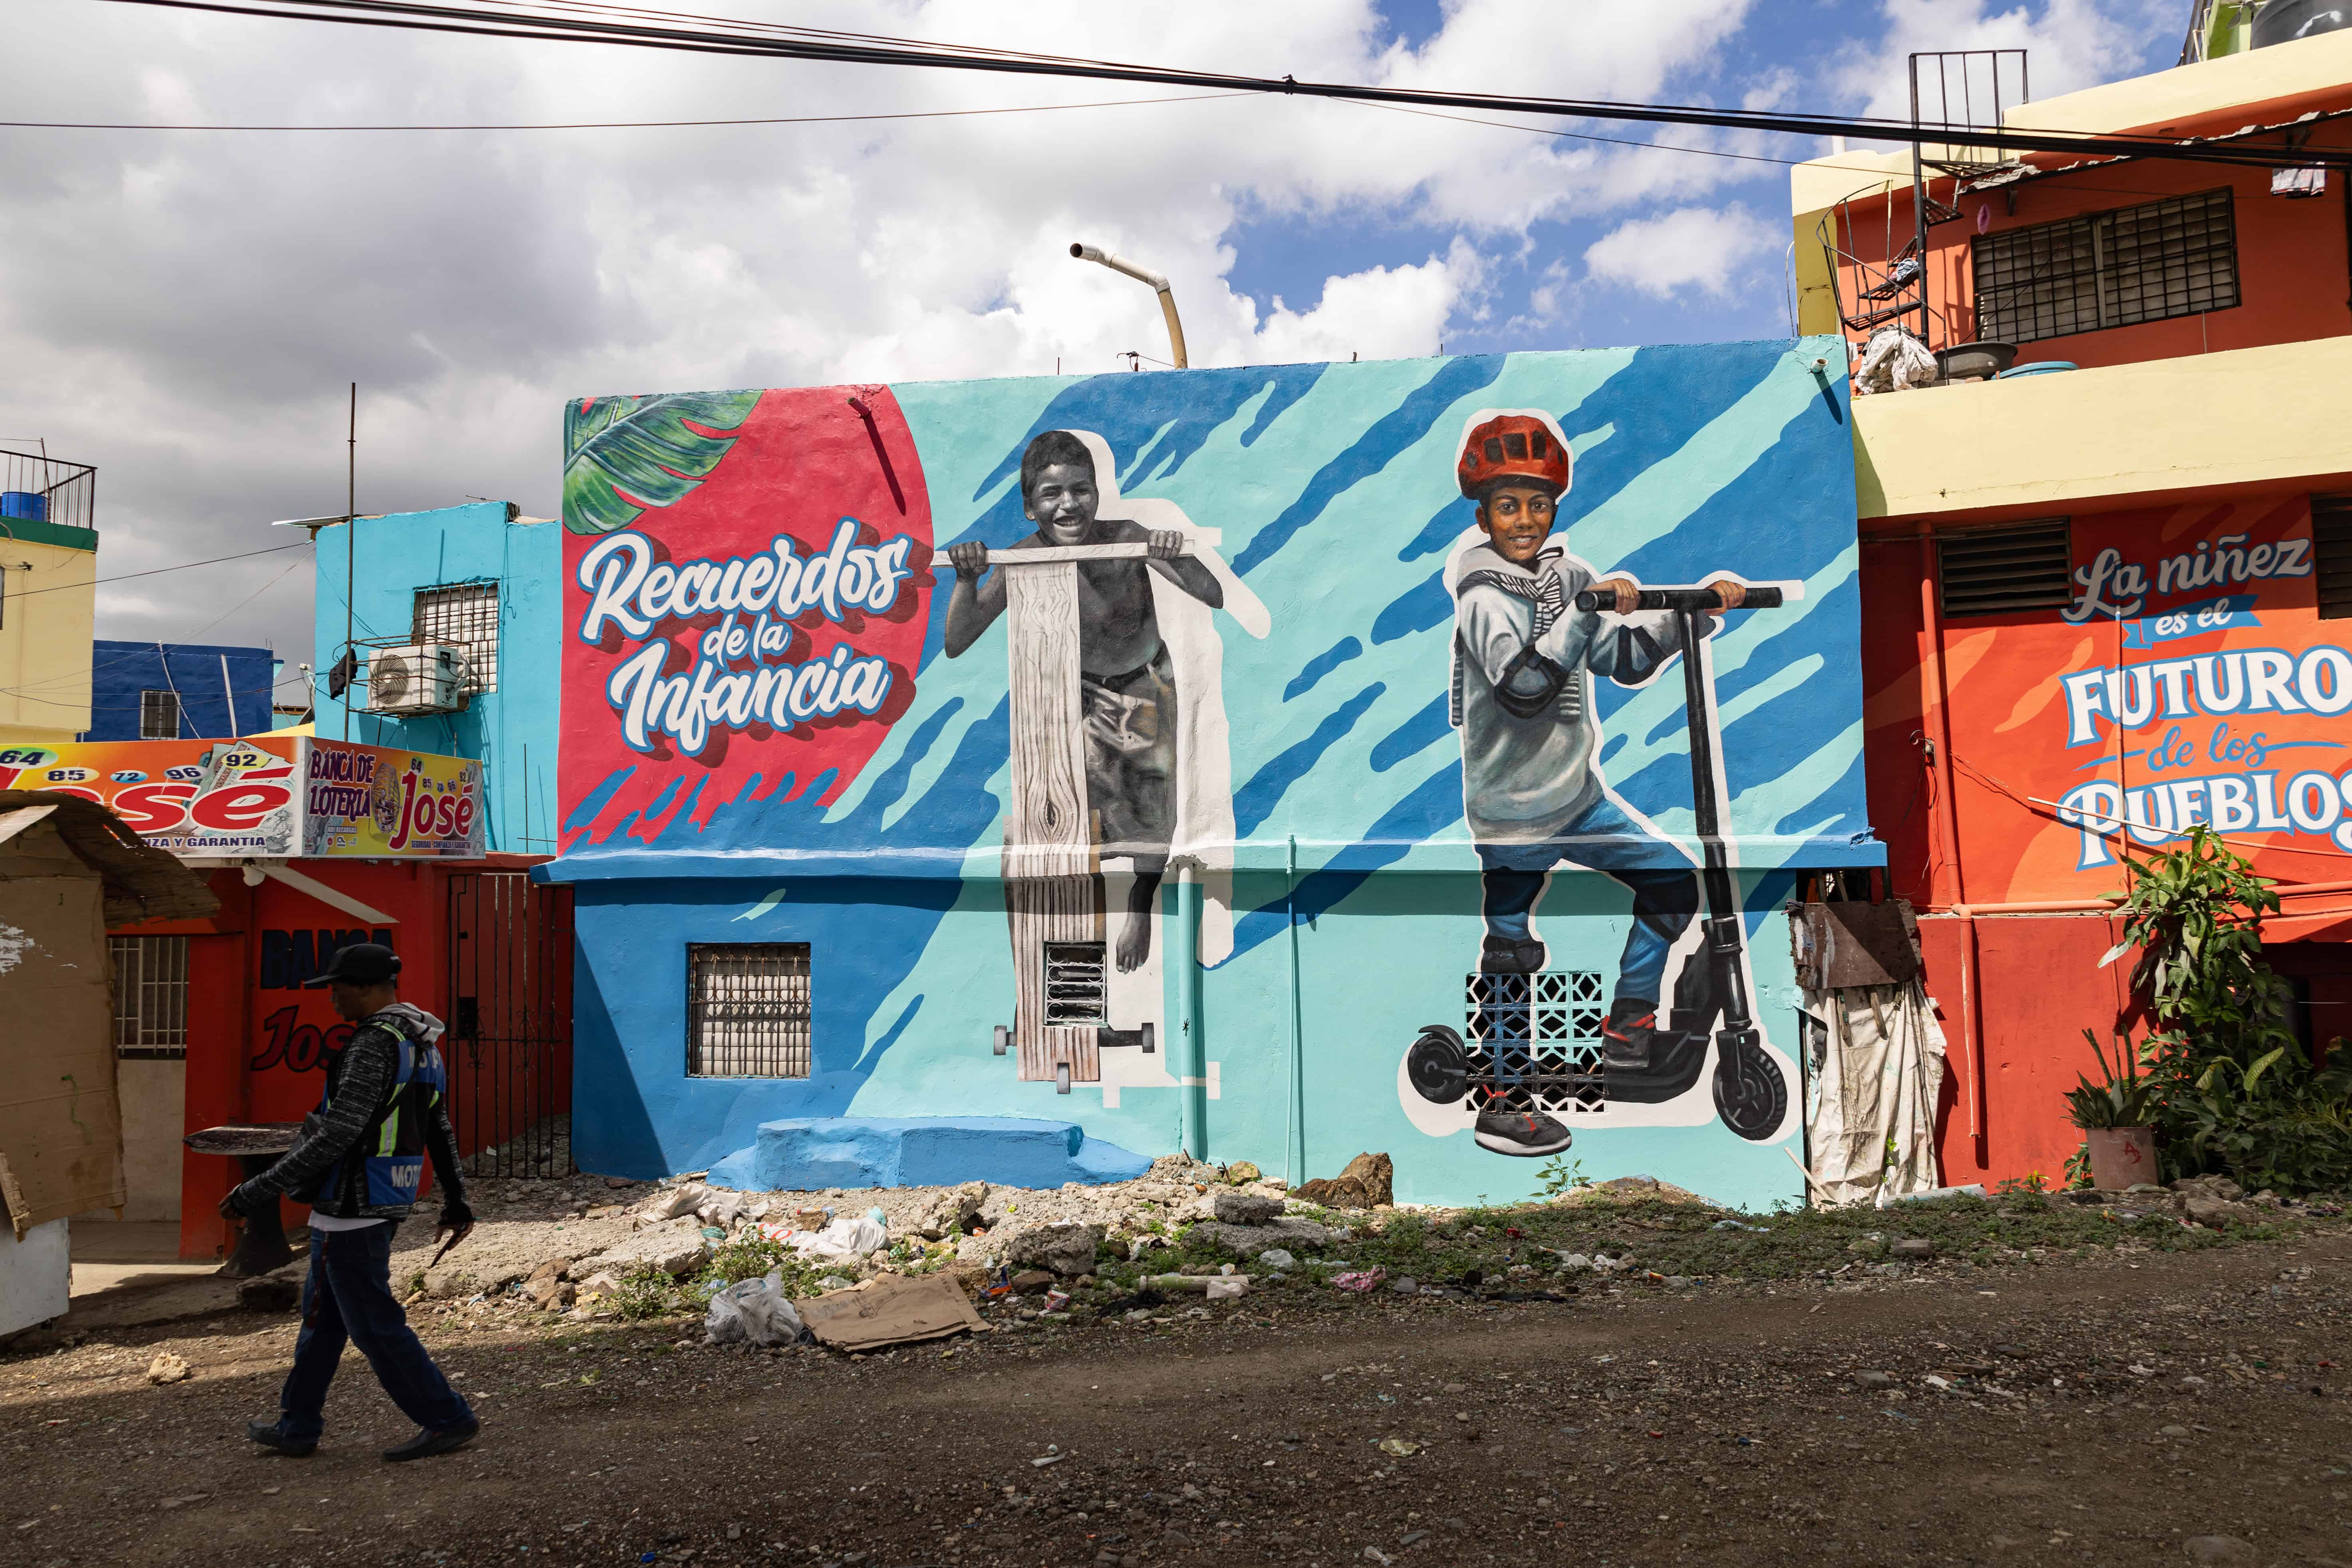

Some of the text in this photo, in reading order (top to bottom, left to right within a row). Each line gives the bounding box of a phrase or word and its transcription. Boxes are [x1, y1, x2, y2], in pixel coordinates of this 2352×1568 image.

[581, 520, 909, 639] Recuerdos
[2061, 534, 2311, 621] La niñez
[2155, 598, 2234, 636] es el
[703, 613, 789, 667] de la
[610, 642, 888, 752] Infancia
[2064, 648, 2352, 744] FUTURO
[0, 750, 45, 765] 64
[2147, 722, 2268, 772] de los
[226, 754, 257, 767] 92
[310, 748, 375, 784] BANCA DE
[411, 758, 422, 773] 64
[48, 770, 86, 781] 85
[115, 772, 139, 781] 72
[166, 767, 201, 780] 96
[423, 778, 432, 788] 85
[448, 781, 456, 791] 96
[460, 772, 466, 782] 92
[0, 766, 295, 832] sé
[437, 783, 444, 791] 72
[309, 786, 371, 822] LOTERIA
[388, 770, 474, 850] José
[172, 838, 184, 847] Y
[187, 837, 266, 847] GARANTIA
